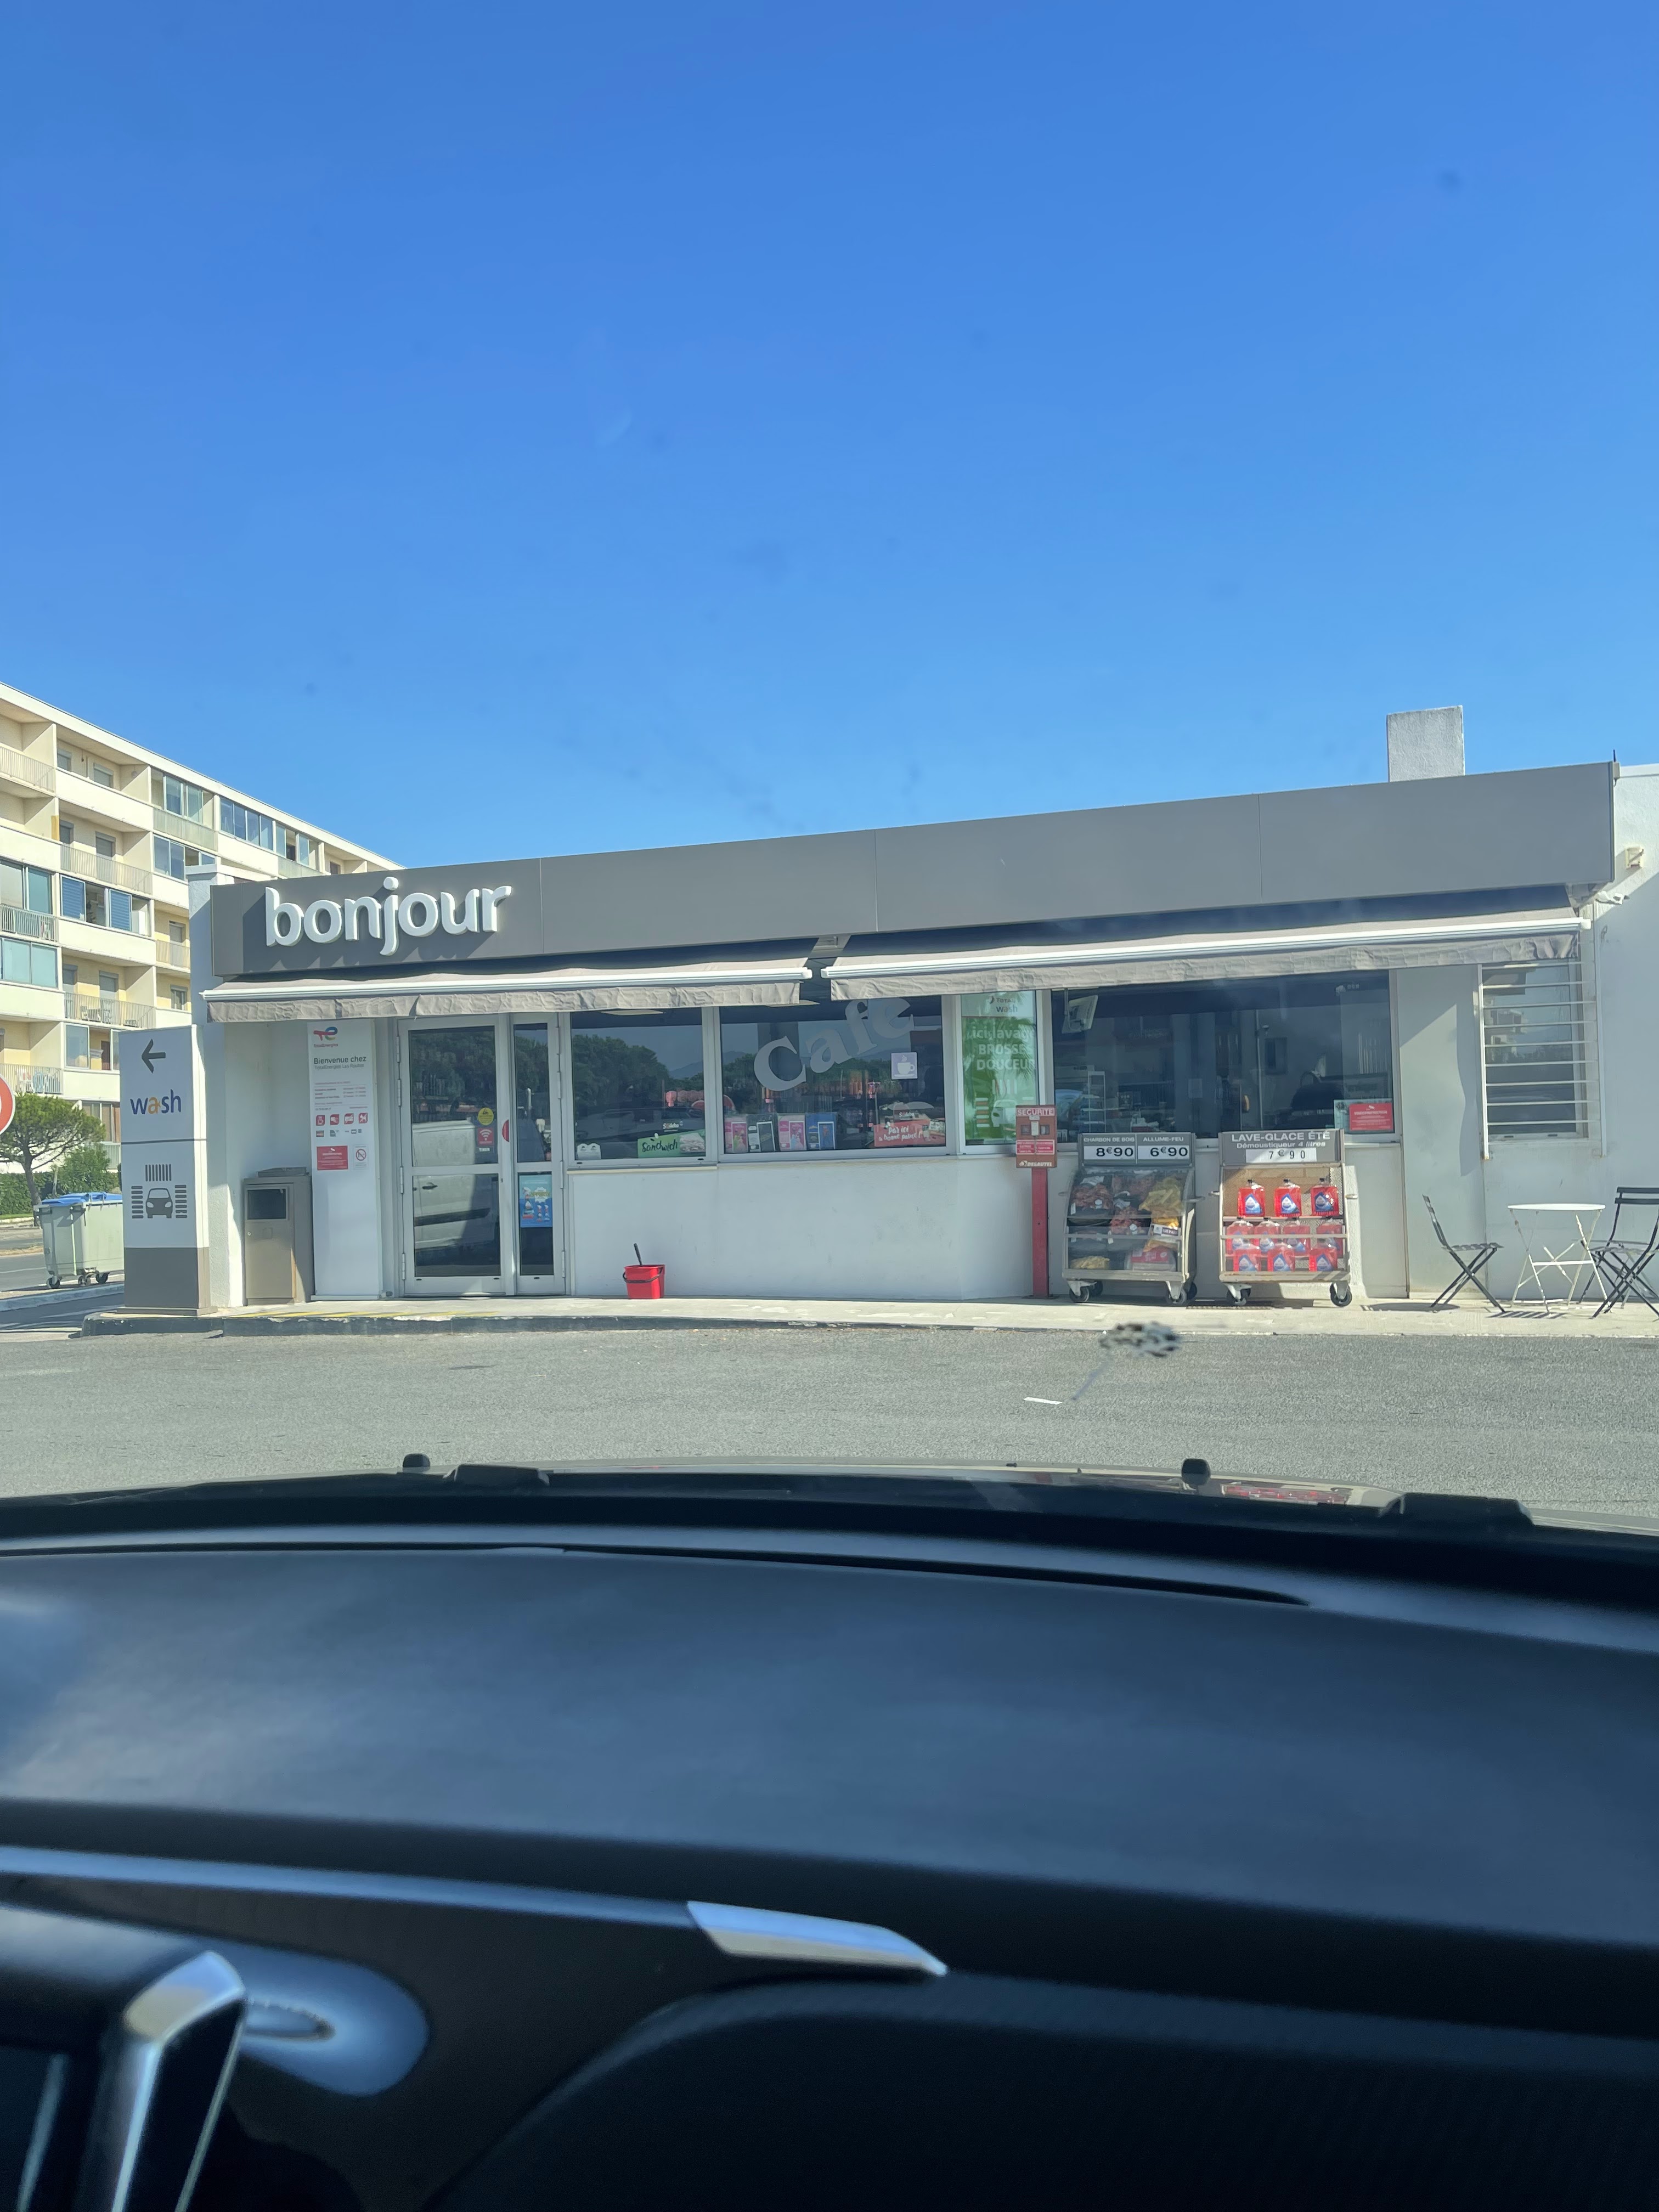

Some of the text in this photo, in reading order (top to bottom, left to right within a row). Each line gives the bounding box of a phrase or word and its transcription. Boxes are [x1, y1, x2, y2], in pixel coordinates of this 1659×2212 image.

[265, 876, 512, 956] bonjour
[996, 1004, 1018, 1013] wash
[129, 1088, 182, 1115] wash
[1232, 1130, 1330, 1142] LAVE-GLACE ÉTÉ
